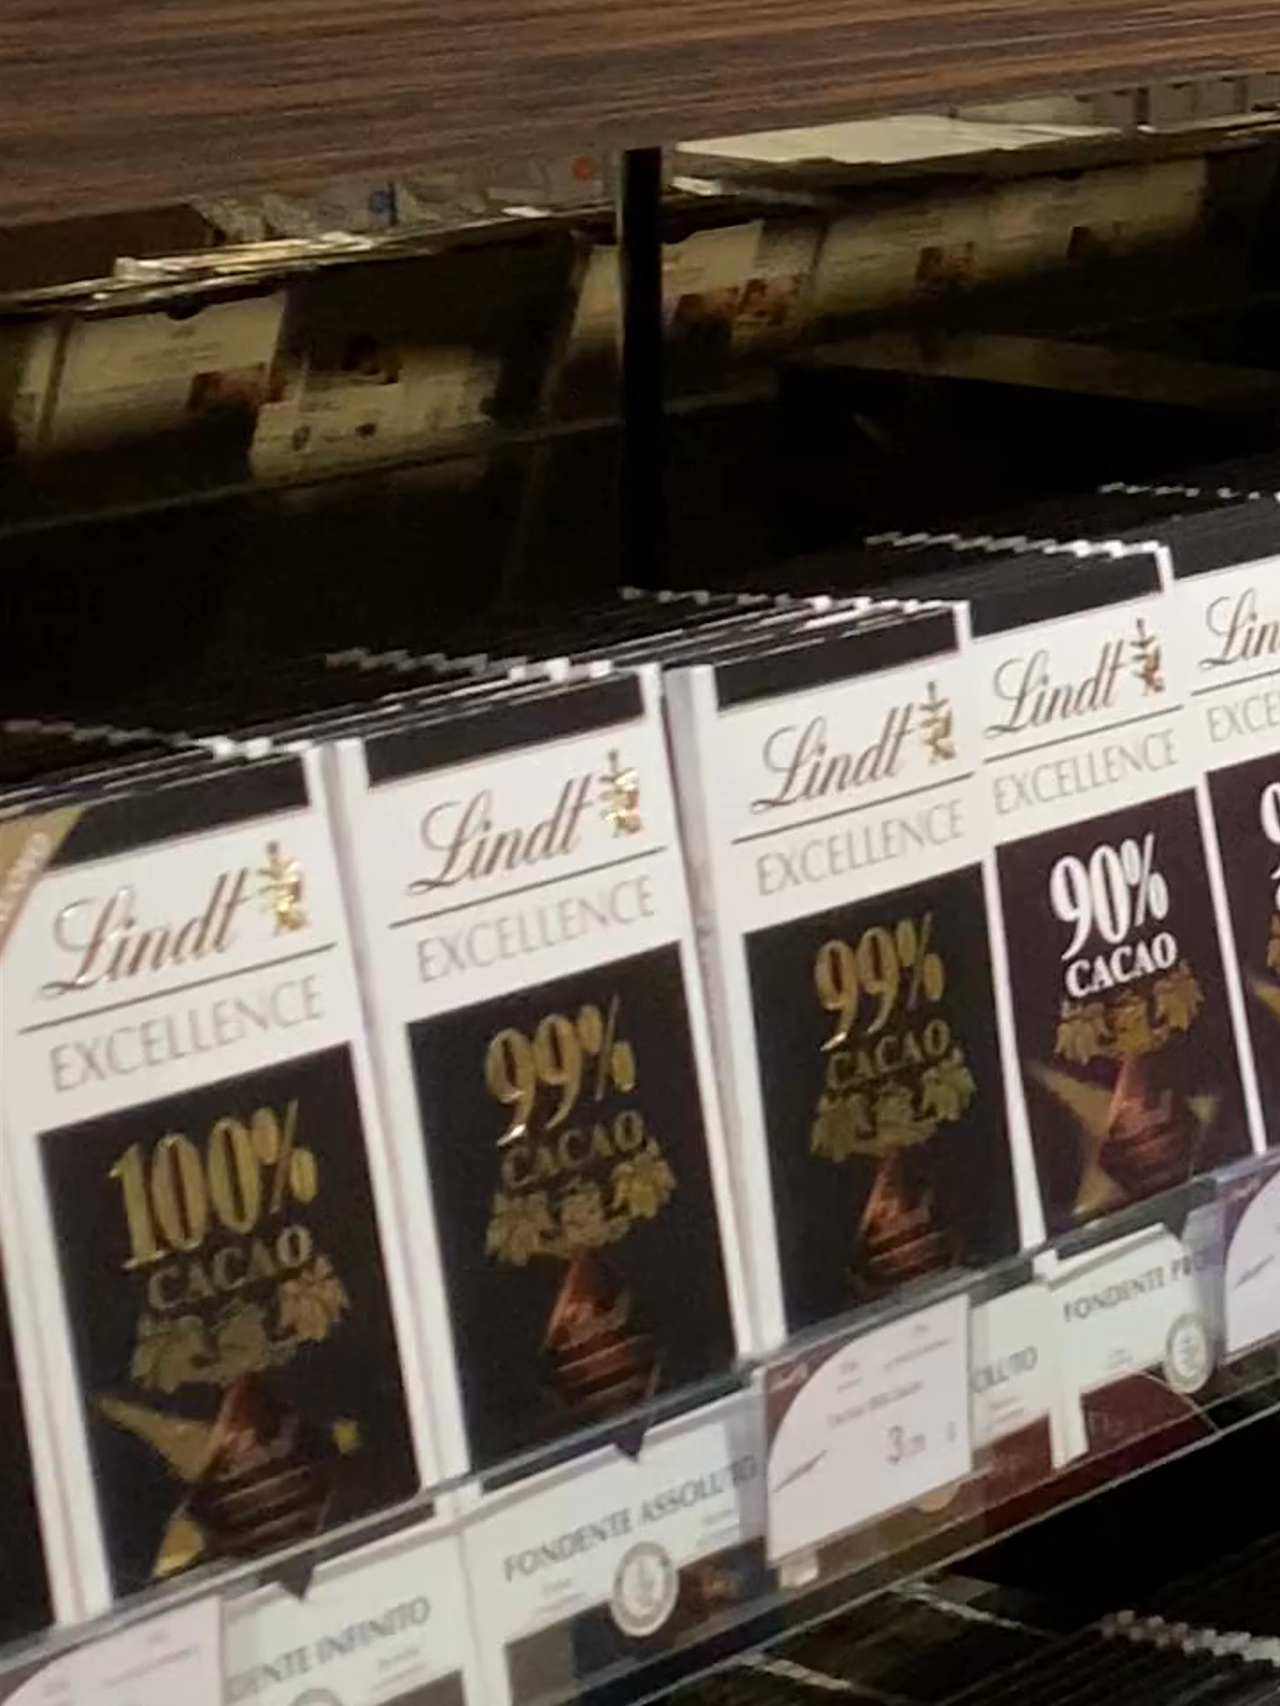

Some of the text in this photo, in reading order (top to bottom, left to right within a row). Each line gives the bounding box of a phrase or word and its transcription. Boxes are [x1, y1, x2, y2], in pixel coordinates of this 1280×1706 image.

[985, 642, 1126, 736] Lindt
[753, 707, 917, 814] Lindt
[993, 730, 1177, 818] EXCELLENCE
[408, 777, 592, 899] Lindt
[757, 798, 966, 900] EXCELLENCE
[44, 868, 249, 997] Lindt
[416, 875, 658, 984] EXCELLENCE
[1050, 835, 1169, 962] 90%
[812, 913, 944, 1052] 99%
[1066, 931, 1177, 997] CACAO
[49, 977, 325, 1092] EXCELLENCE
[484, 992, 637, 1150] 99%
[109, 1101, 320, 1272] 100%
[501, 1109, 647, 1190] CACAO
[147, 1223, 312, 1317] CACAO
